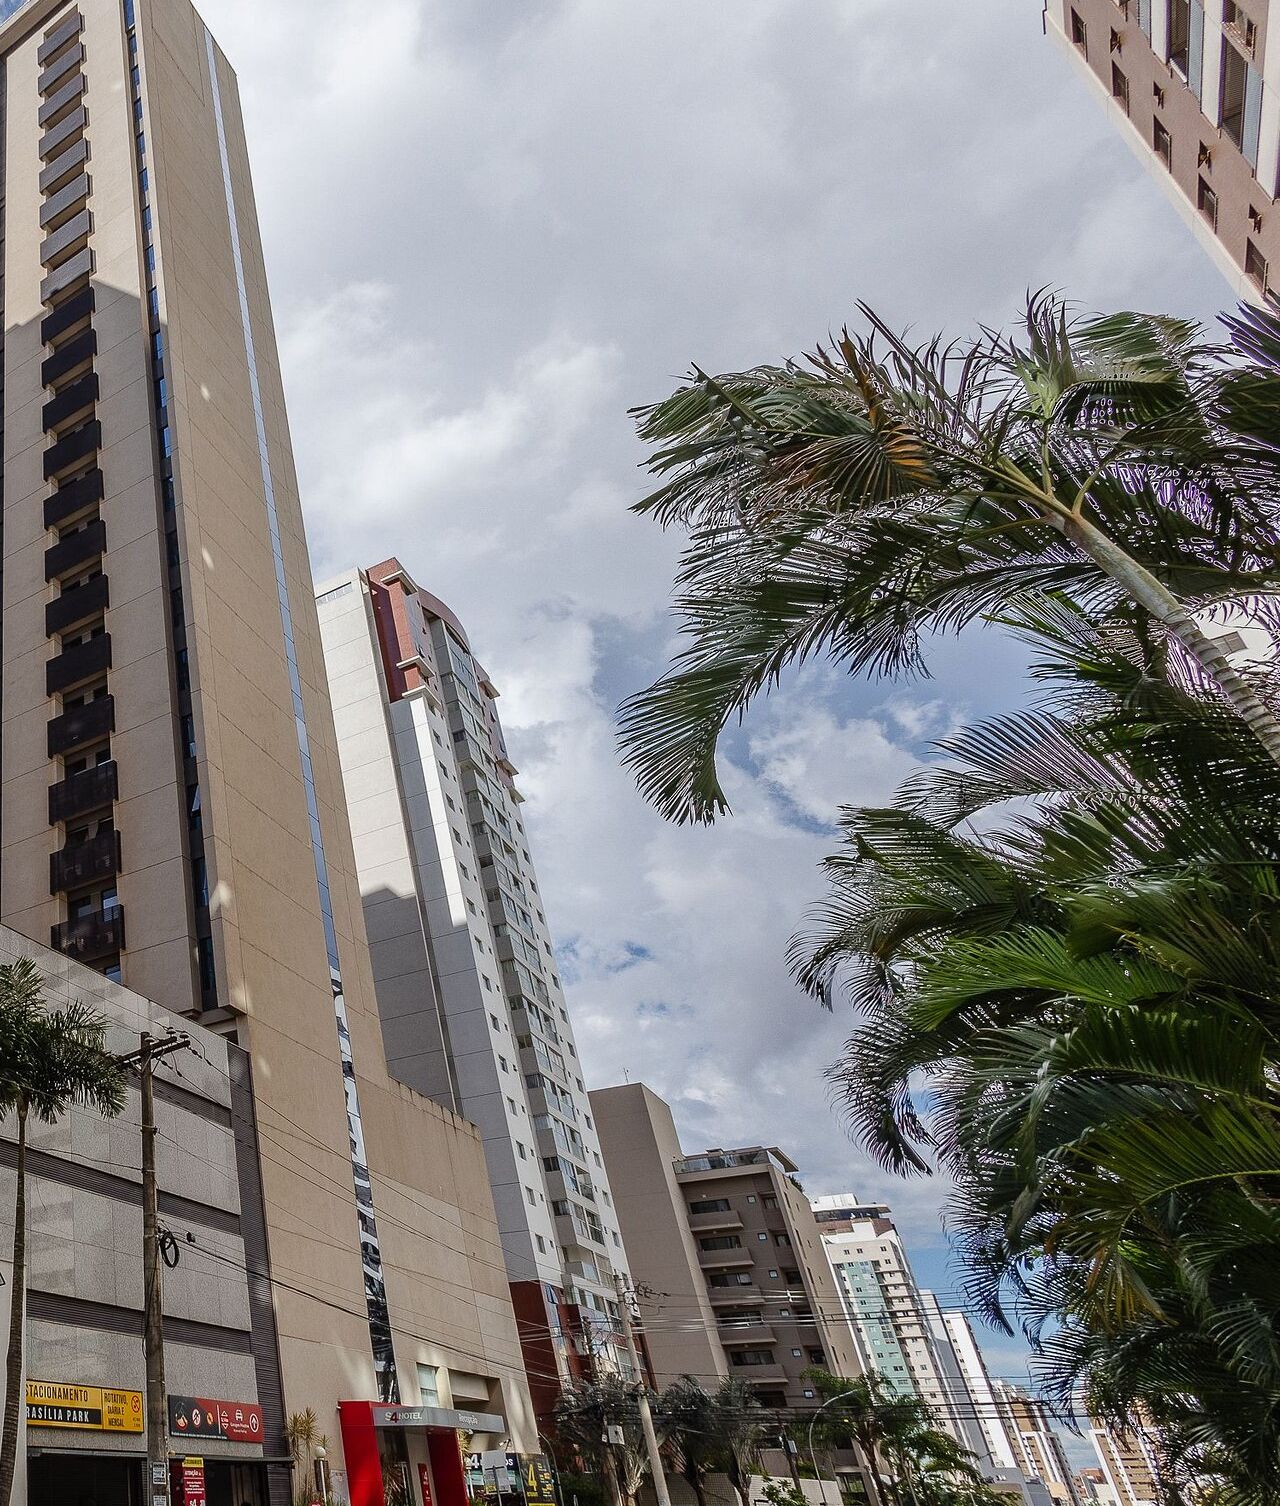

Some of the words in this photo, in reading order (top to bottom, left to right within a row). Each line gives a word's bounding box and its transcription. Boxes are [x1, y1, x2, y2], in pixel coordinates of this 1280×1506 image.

[26, 1383, 88, 1402] STACIONAMENTO
[25, 1405, 63, 1421] RASÍLIA
[66, 1409, 89, 1422] PARK
[398, 1411, 423, 1420] HOTEL
